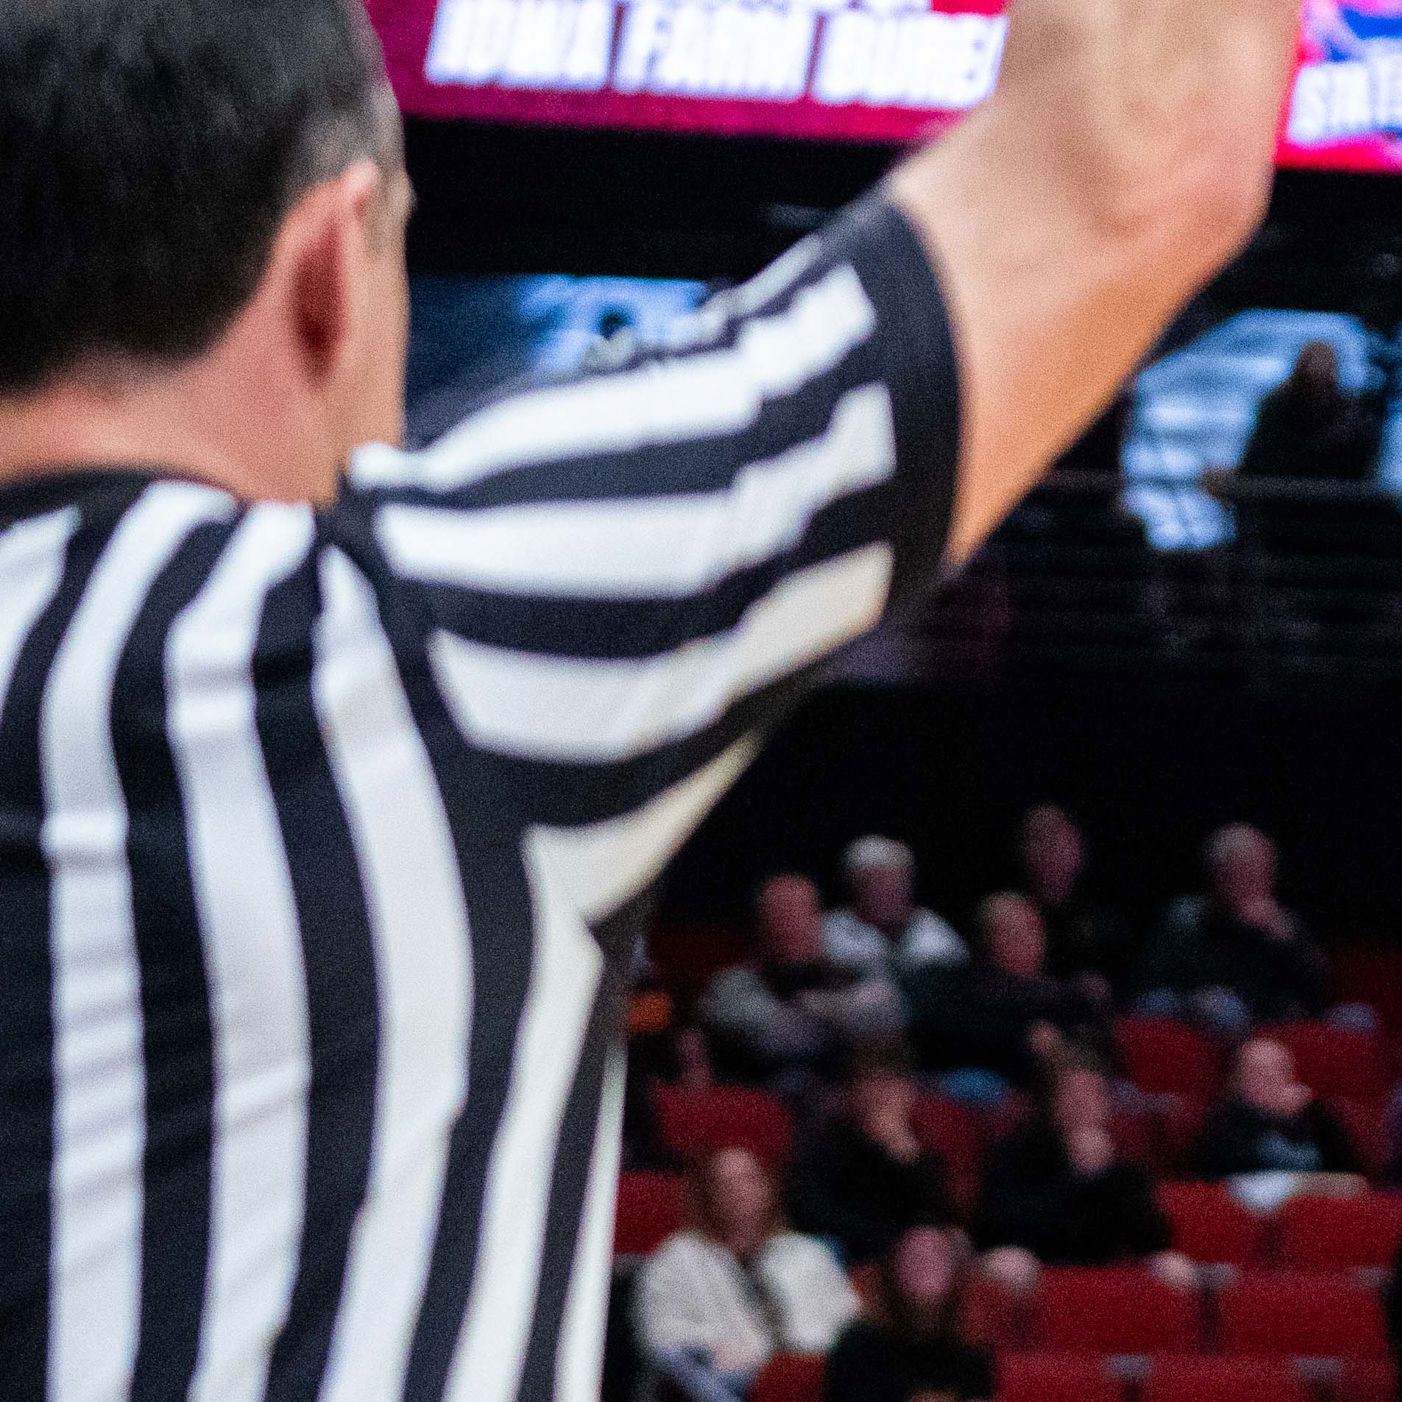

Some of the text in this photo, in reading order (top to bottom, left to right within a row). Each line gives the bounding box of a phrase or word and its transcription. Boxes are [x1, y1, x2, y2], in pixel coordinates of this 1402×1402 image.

[424, 0, 1010, 109] IOWA FARM BURE
